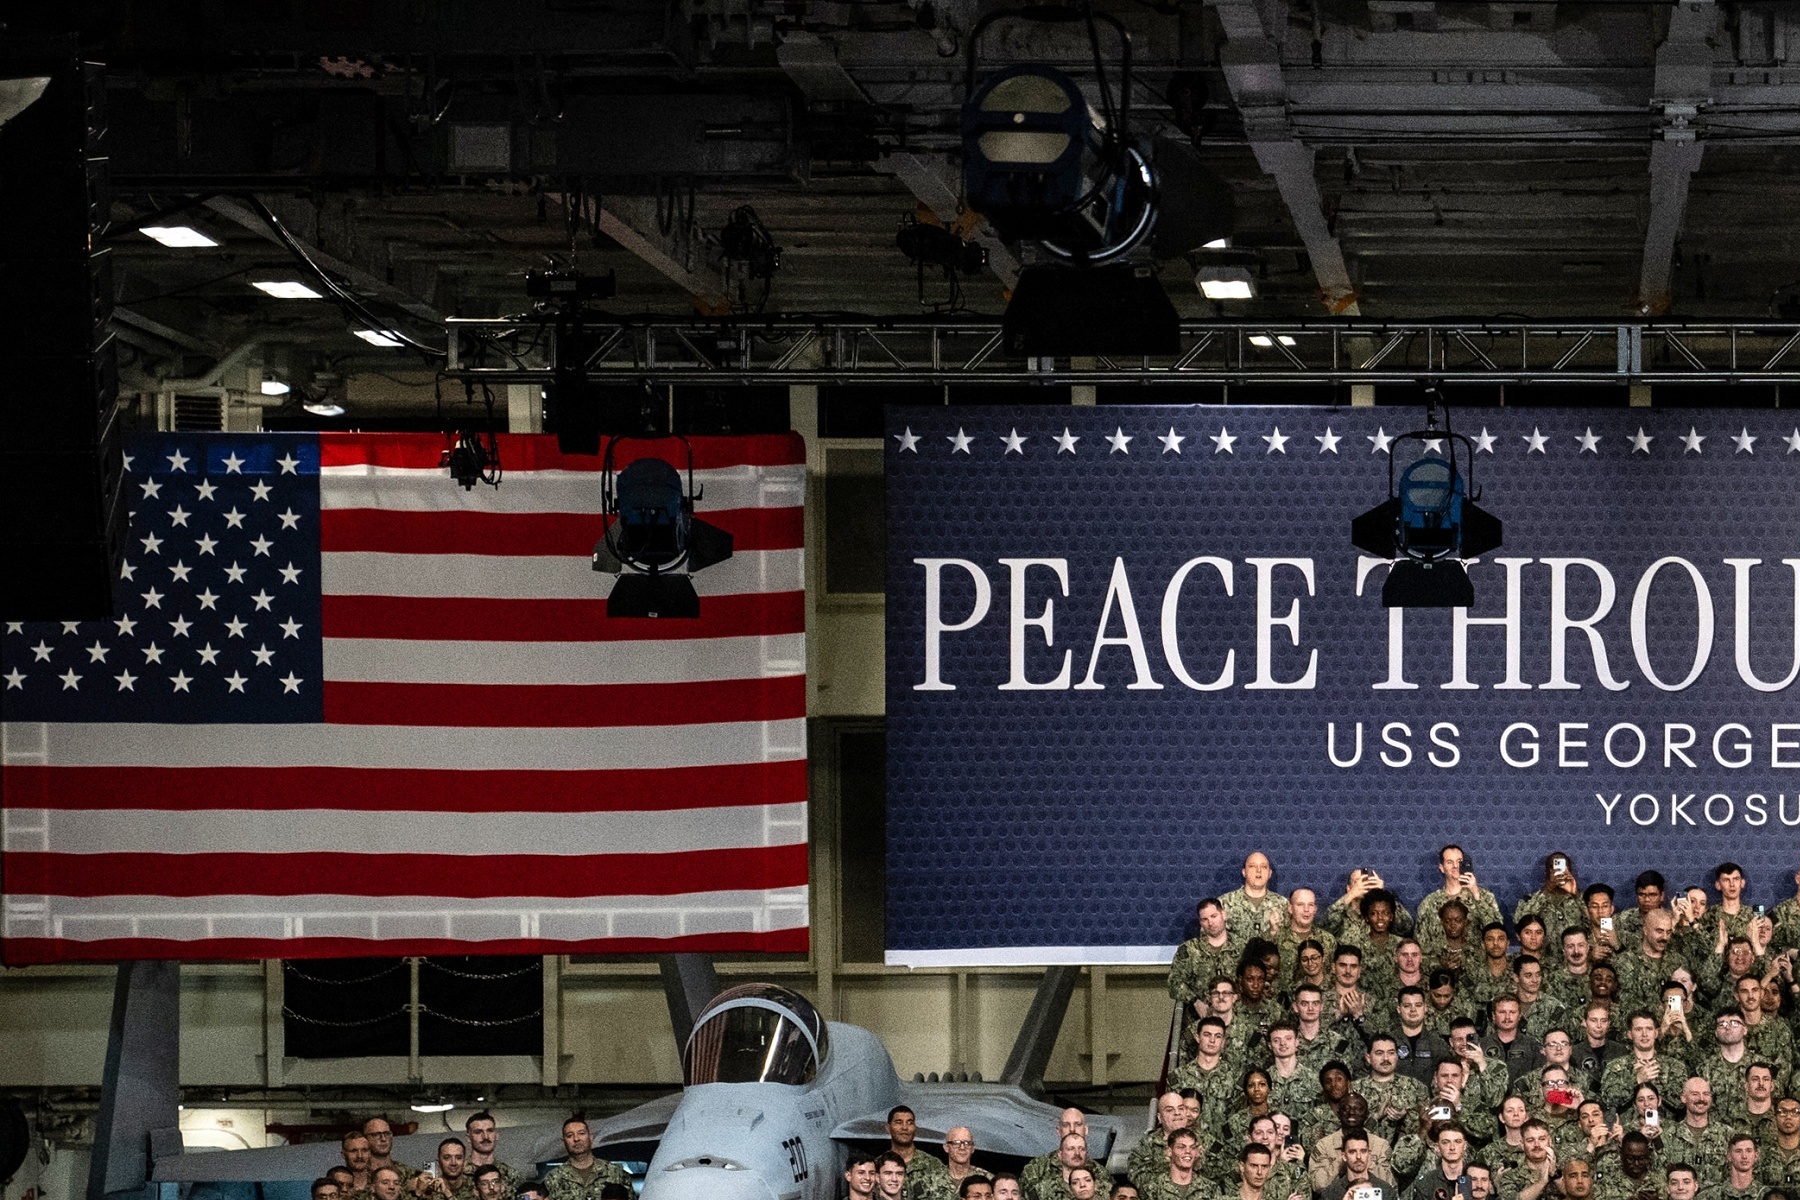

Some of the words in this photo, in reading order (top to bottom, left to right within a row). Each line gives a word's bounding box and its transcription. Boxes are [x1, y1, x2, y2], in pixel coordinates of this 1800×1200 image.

[913, 556, 1318, 692] PEACE
[1327, 722, 1461, 768] USS
[781, 1135, 809, 1184] 200
